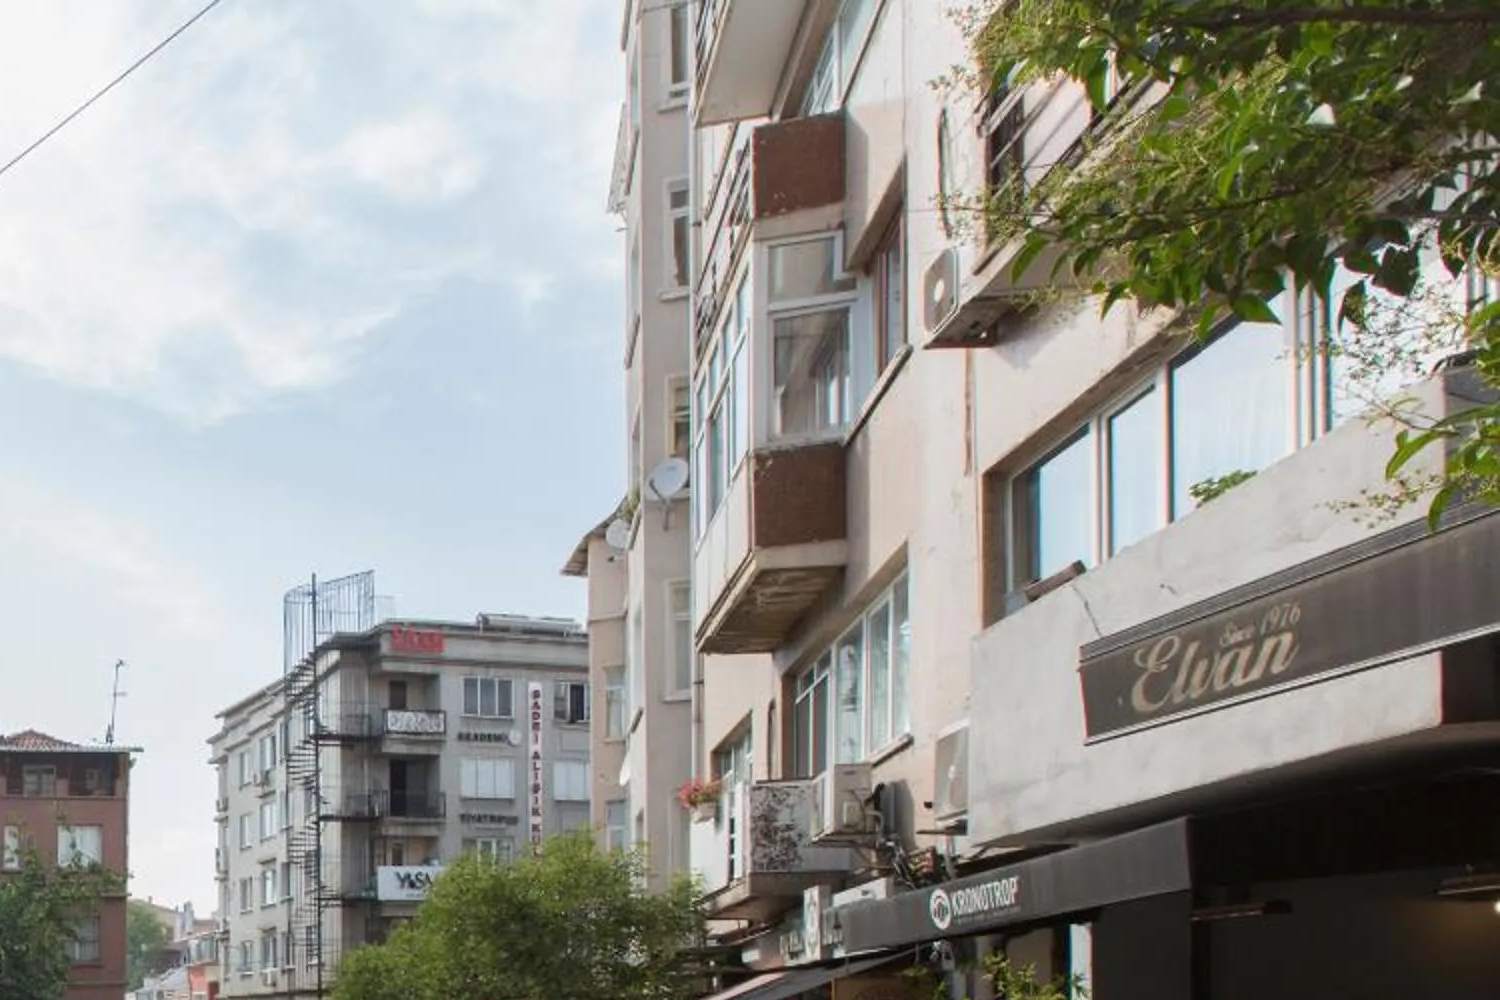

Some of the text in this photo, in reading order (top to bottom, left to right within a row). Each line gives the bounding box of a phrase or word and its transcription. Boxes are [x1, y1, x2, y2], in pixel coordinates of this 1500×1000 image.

[1260, 602, 1301, 635] 1976
[1131, 631, 1299, 713] Elvan
[950, 875, 1020, 917] KRONOTROP
